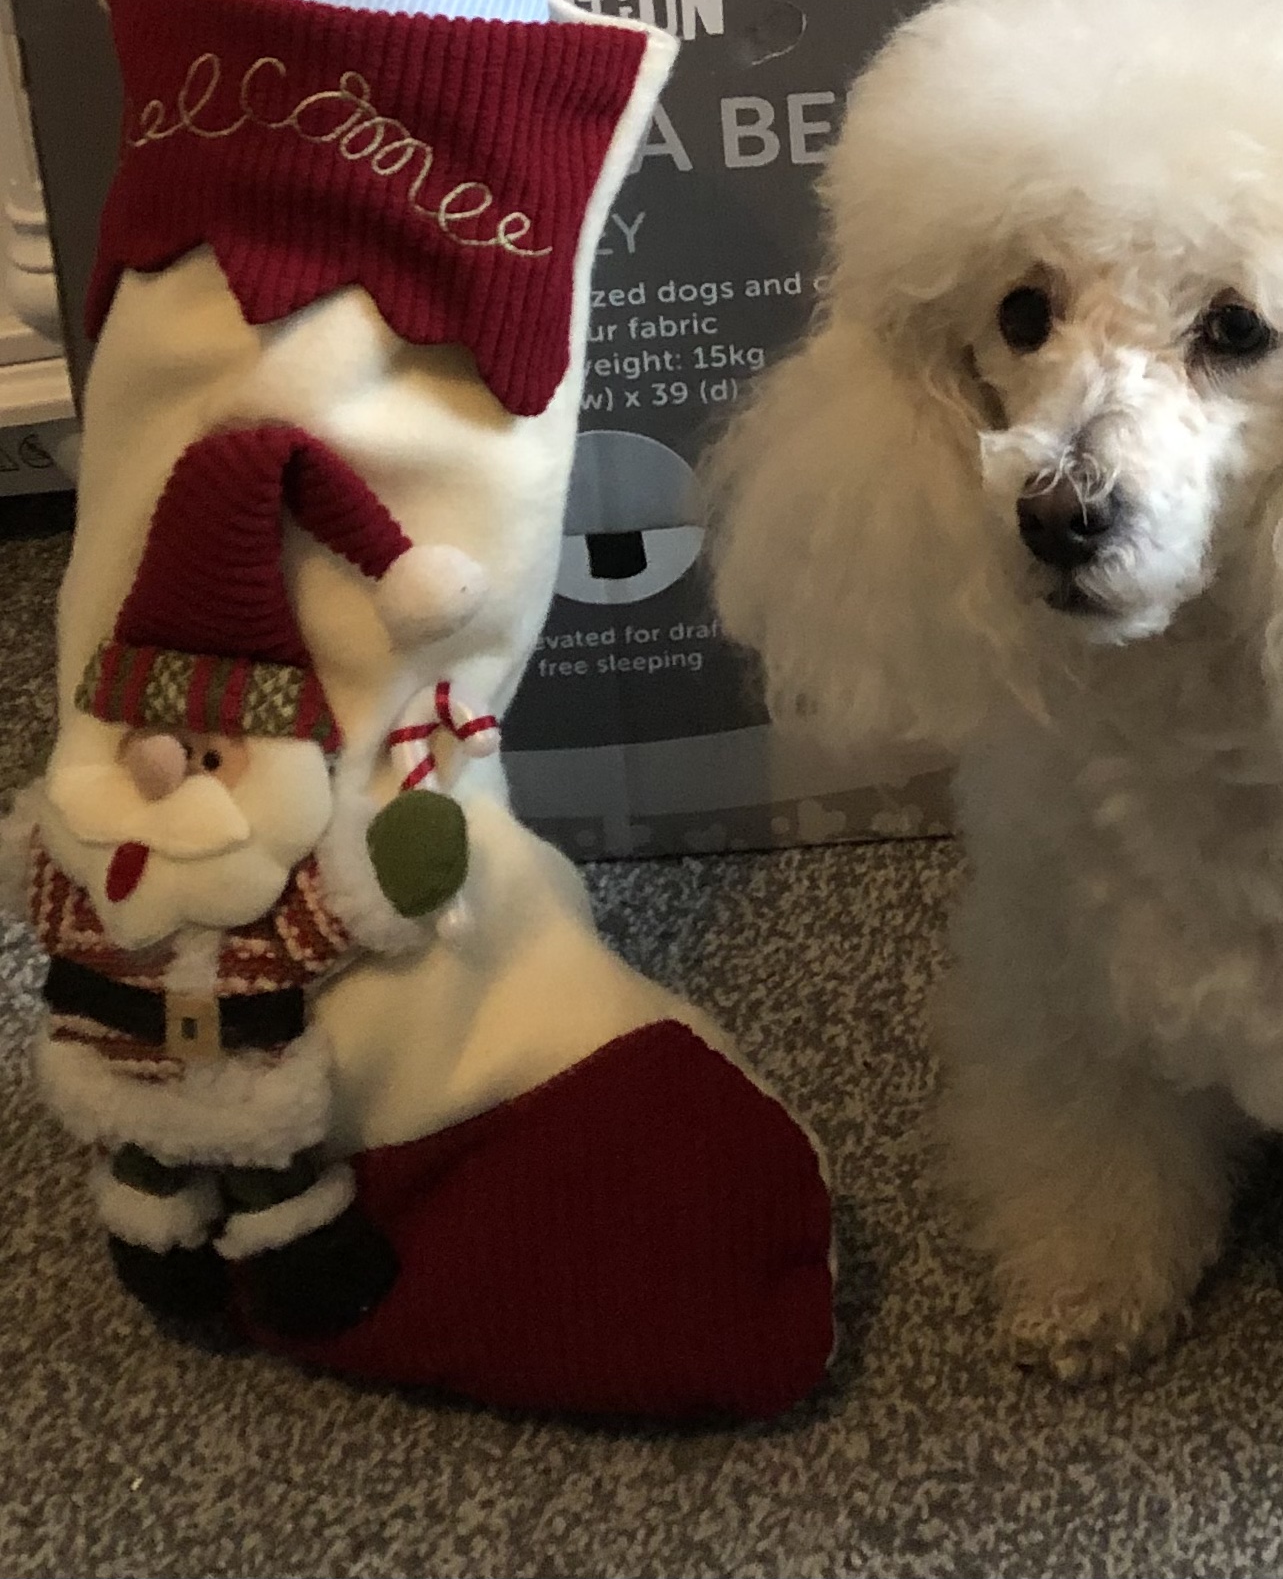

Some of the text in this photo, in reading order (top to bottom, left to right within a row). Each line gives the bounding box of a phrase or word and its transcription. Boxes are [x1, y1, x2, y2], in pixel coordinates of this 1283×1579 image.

[720, 90, 853, 168] BE
[591, 282, 646, 307] zed
[657, 279, 734, 305] dogs
[745, 272, 801, 297] and
[628, 312, 718, 339] fabric
[585, 344, 765, 380] eight: 15kg
[624, 390, 641, 408] x
[651, 381, 688, 406] 39
[700, 378, 738, 404] (d)
[624, 625, 661, 644] for
[538, 650, 703, 677] free sleeping
